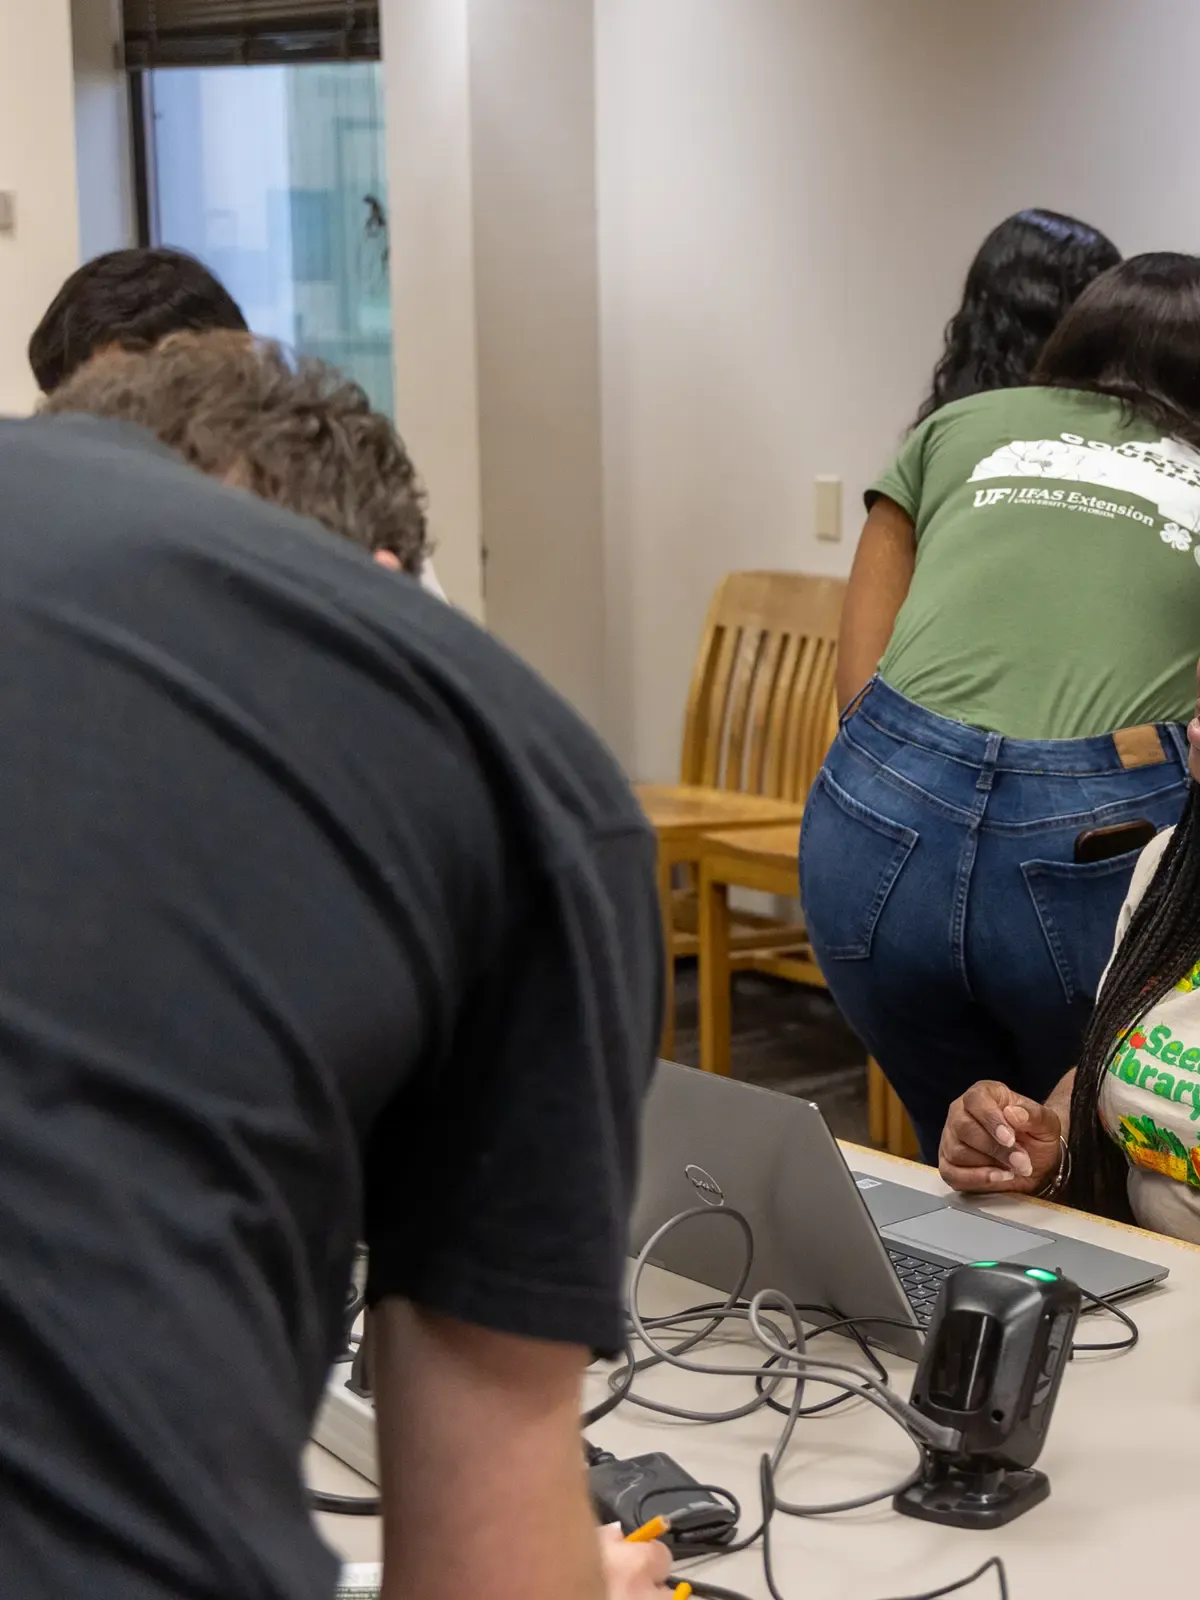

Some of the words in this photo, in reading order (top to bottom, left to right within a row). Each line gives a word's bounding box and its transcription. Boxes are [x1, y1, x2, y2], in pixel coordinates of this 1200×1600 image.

[973, 487, 1013, 507] UF
[1017, 488, 1066, 501] IFAS
[1067, 491, 1155, 528] Extension
[1014, 497, 1068, 509] UNIVERSITY
